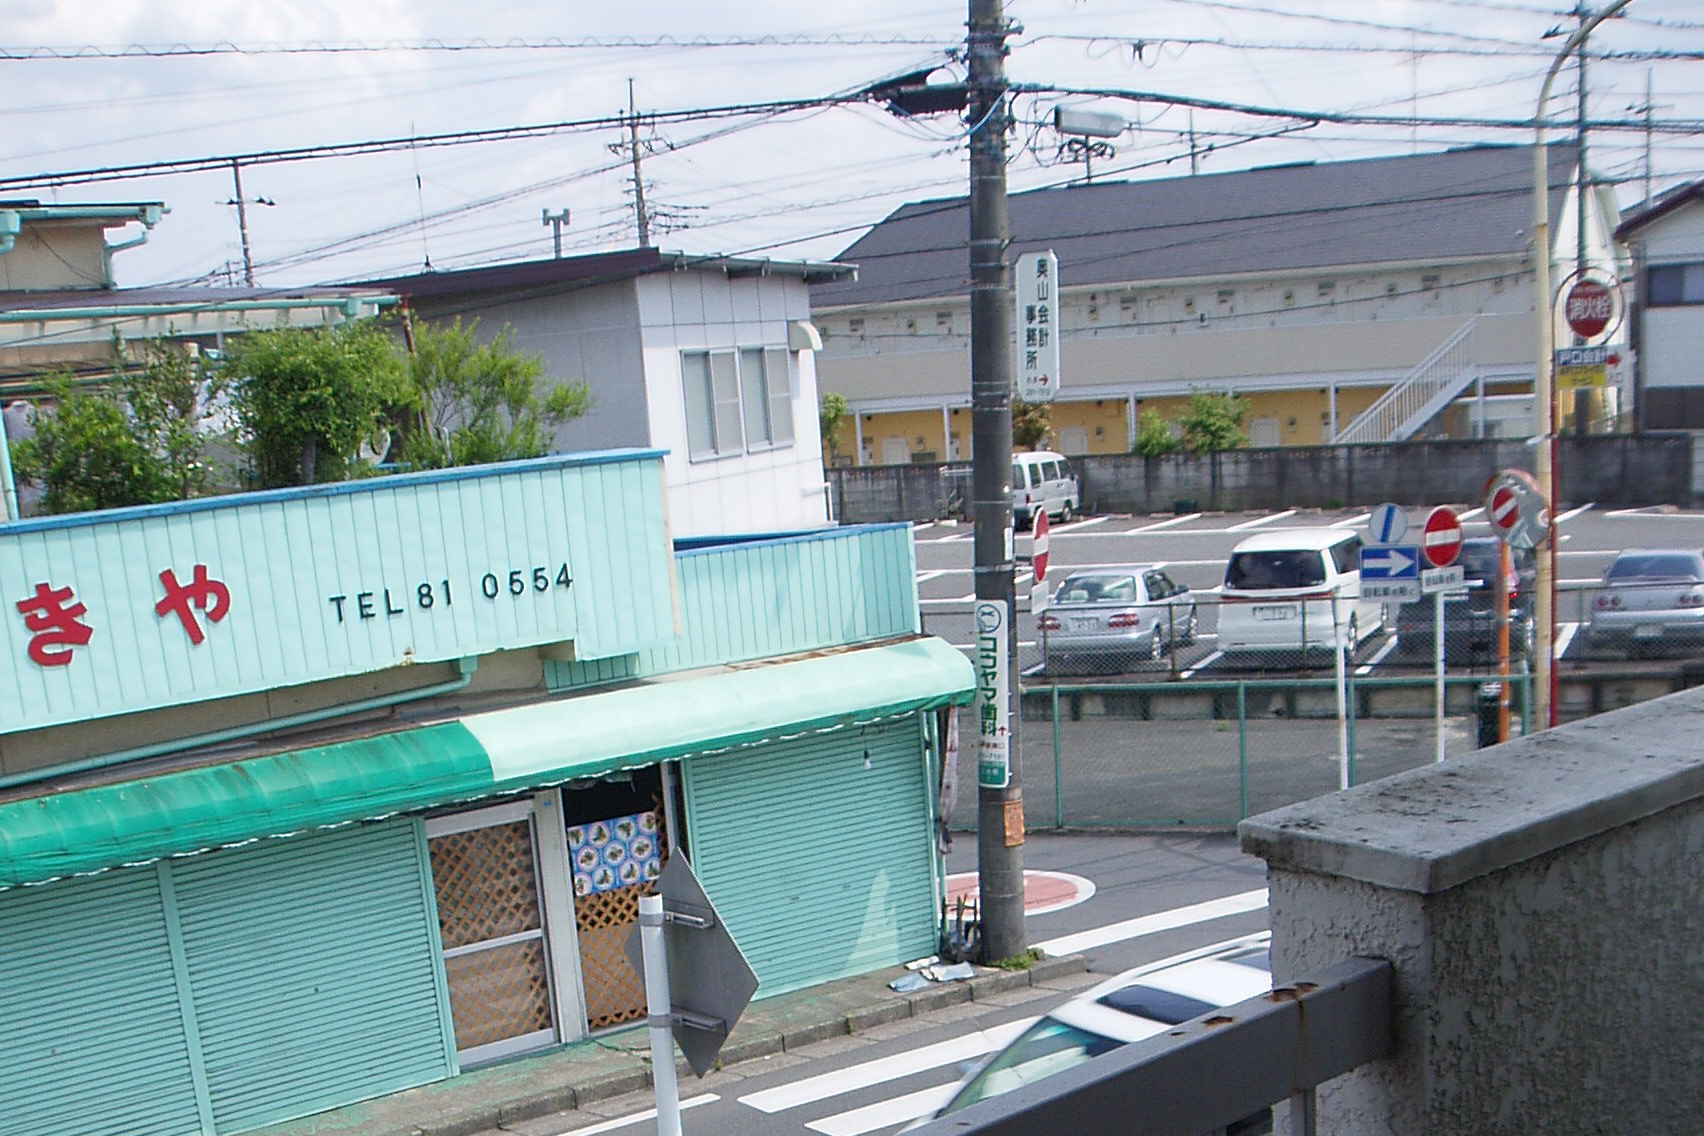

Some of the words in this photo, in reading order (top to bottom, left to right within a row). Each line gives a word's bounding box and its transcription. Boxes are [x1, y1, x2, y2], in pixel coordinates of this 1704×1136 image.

[1569, 296, 1611, 321] 消火栓
[329, 587, 405, 624] TEL
[416, 578, 452, 610] 81
[481, 562, 574, 601] 0554
